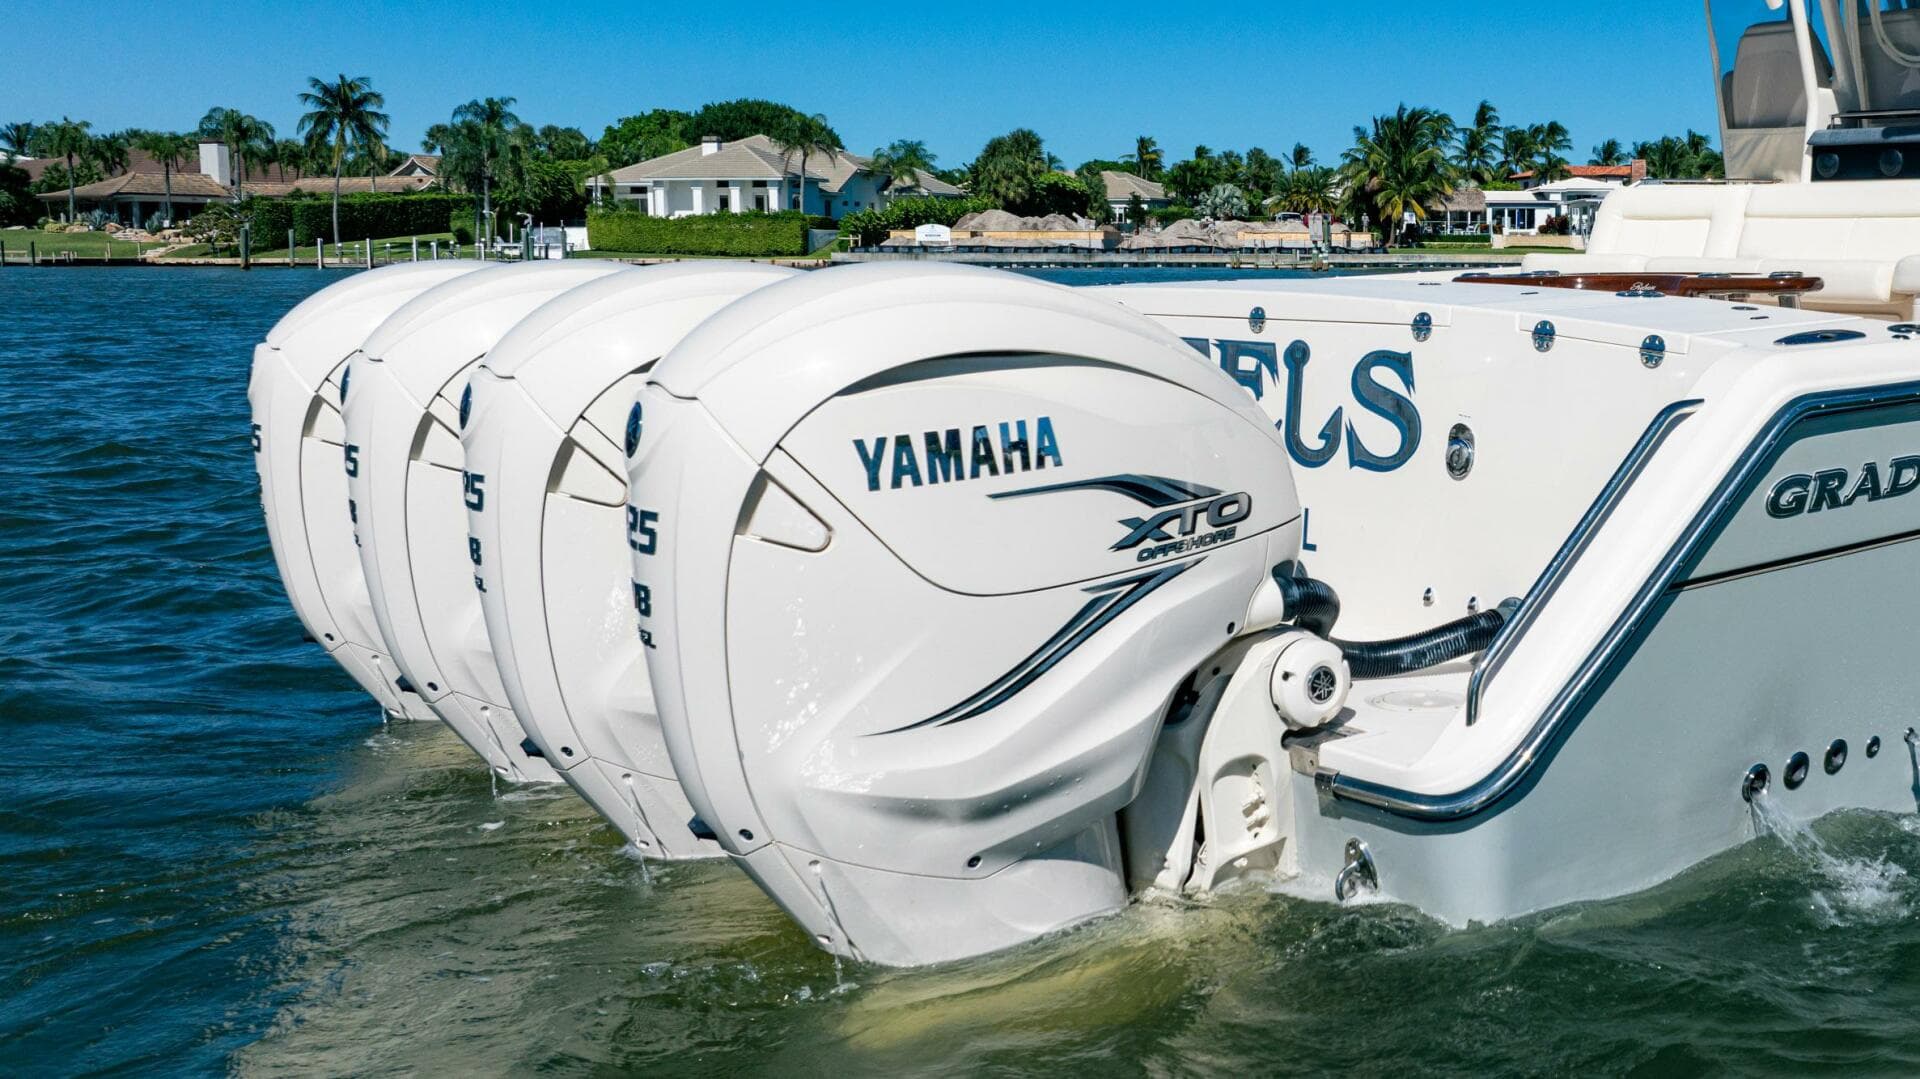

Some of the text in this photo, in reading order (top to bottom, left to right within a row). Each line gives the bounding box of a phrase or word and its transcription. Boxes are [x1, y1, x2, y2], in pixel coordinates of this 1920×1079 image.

[852, 416, 1064, 491] YAMAHA
[1765, 455, 1920, 519] GRAD
[1109, 491, 1253, 552] XTO
[1136, 526, 1237, 562] OFFSHORE
